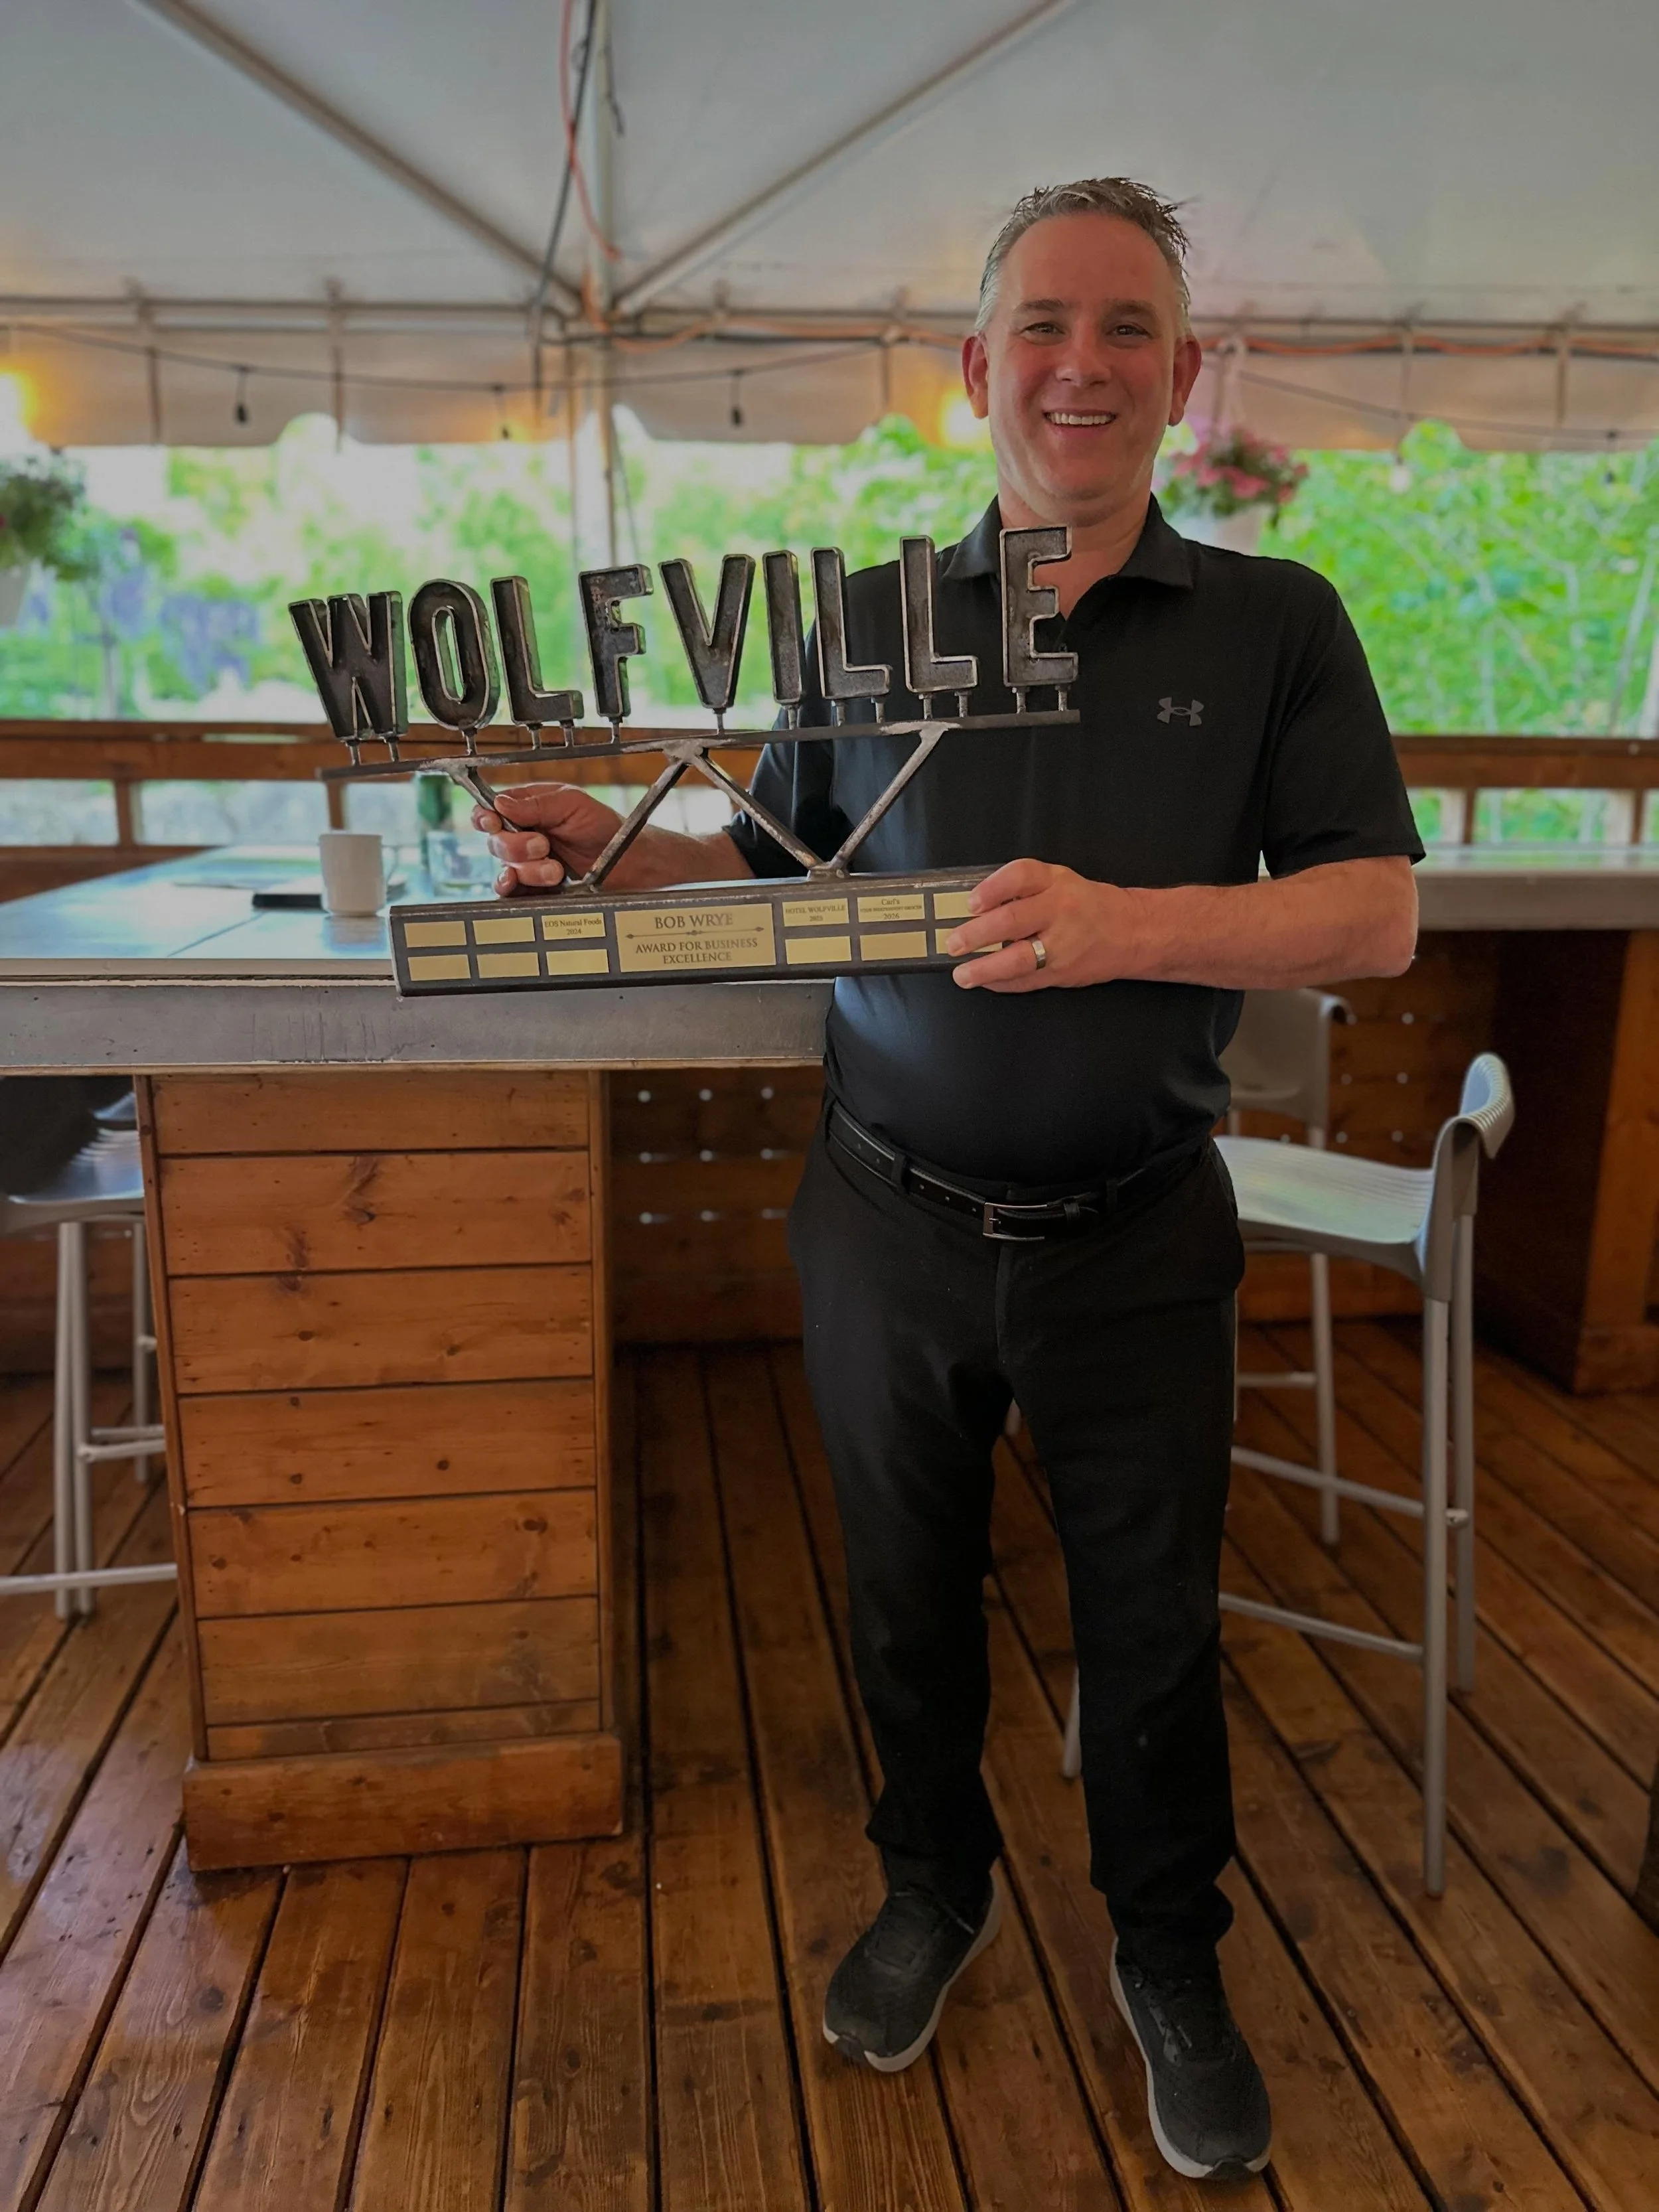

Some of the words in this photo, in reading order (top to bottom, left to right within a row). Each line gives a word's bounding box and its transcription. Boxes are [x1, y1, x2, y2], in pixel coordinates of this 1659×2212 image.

[288, 526, 1079, 741] WOLFVILLE
[655, 916, 685, 929] BOB
[689, 913, 733, 927] WRYE
[636, 942, 676, 954] AWARD
[680, 941, 703, 952] FOR
[705, 938, 758, 950] BUSINESS
[663, 952, 732, 964] EXCELLENCE
